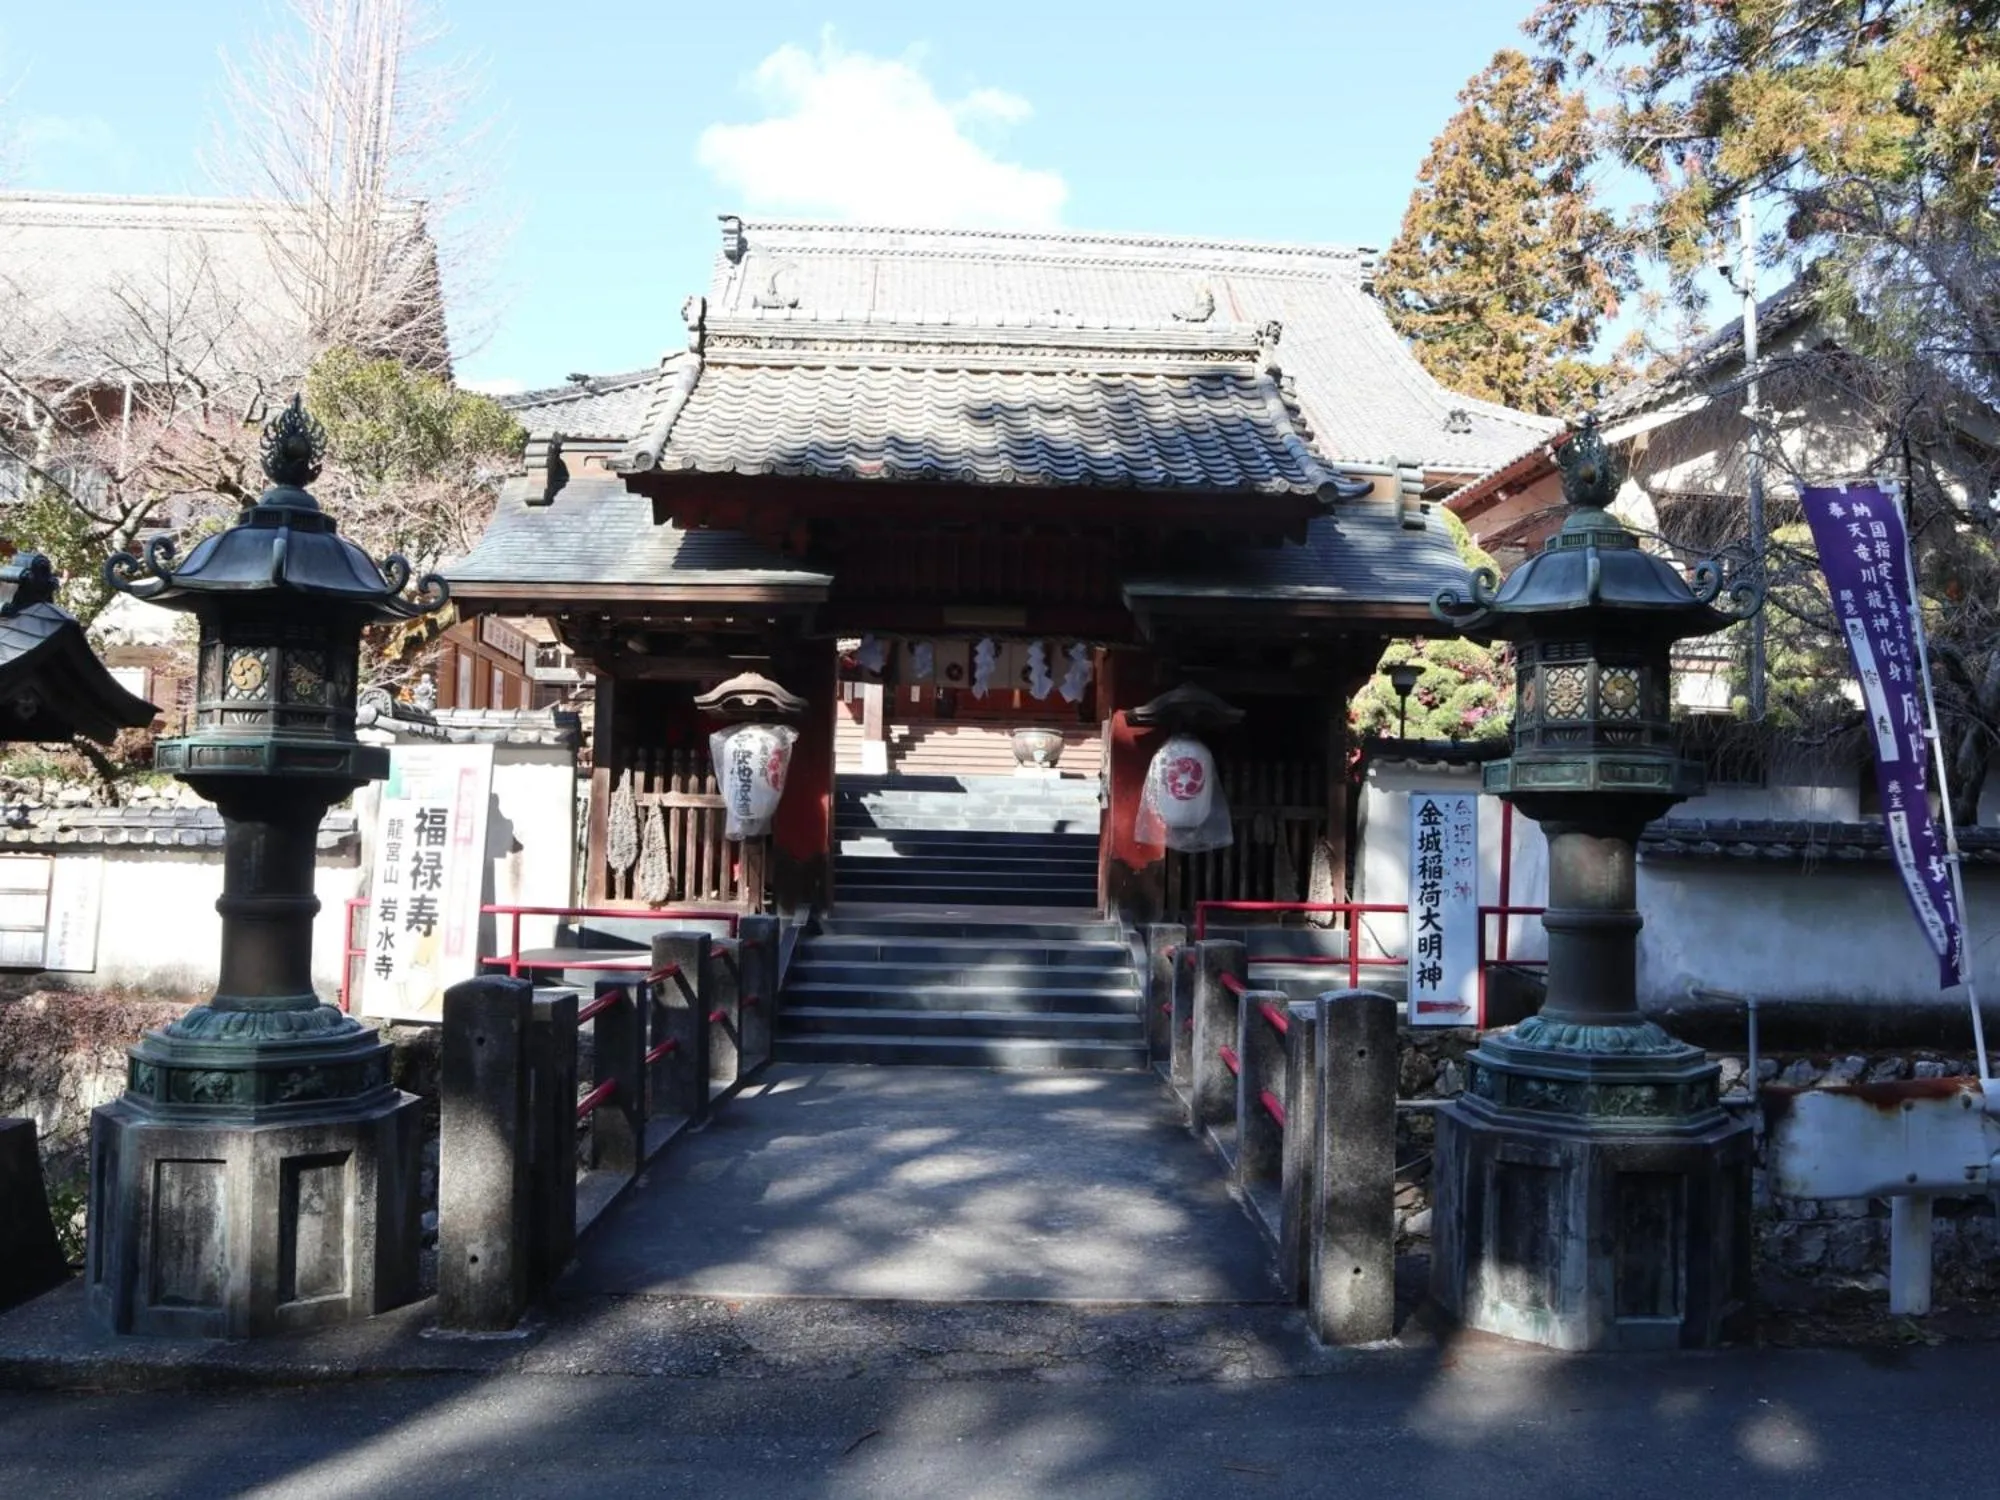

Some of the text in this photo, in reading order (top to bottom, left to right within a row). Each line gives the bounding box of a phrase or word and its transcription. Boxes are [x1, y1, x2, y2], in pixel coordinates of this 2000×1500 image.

[1827, 501, 1872, 519] 奉納
[1846, 521, 1902, 682] 天竜川龍神化身
[374, 817, 404, 981] 龍宮山 岩水寺
[405, 807, 449, 938] 福禄寿
[1416, 799, 1444, 992] 金城稲荷大明神
